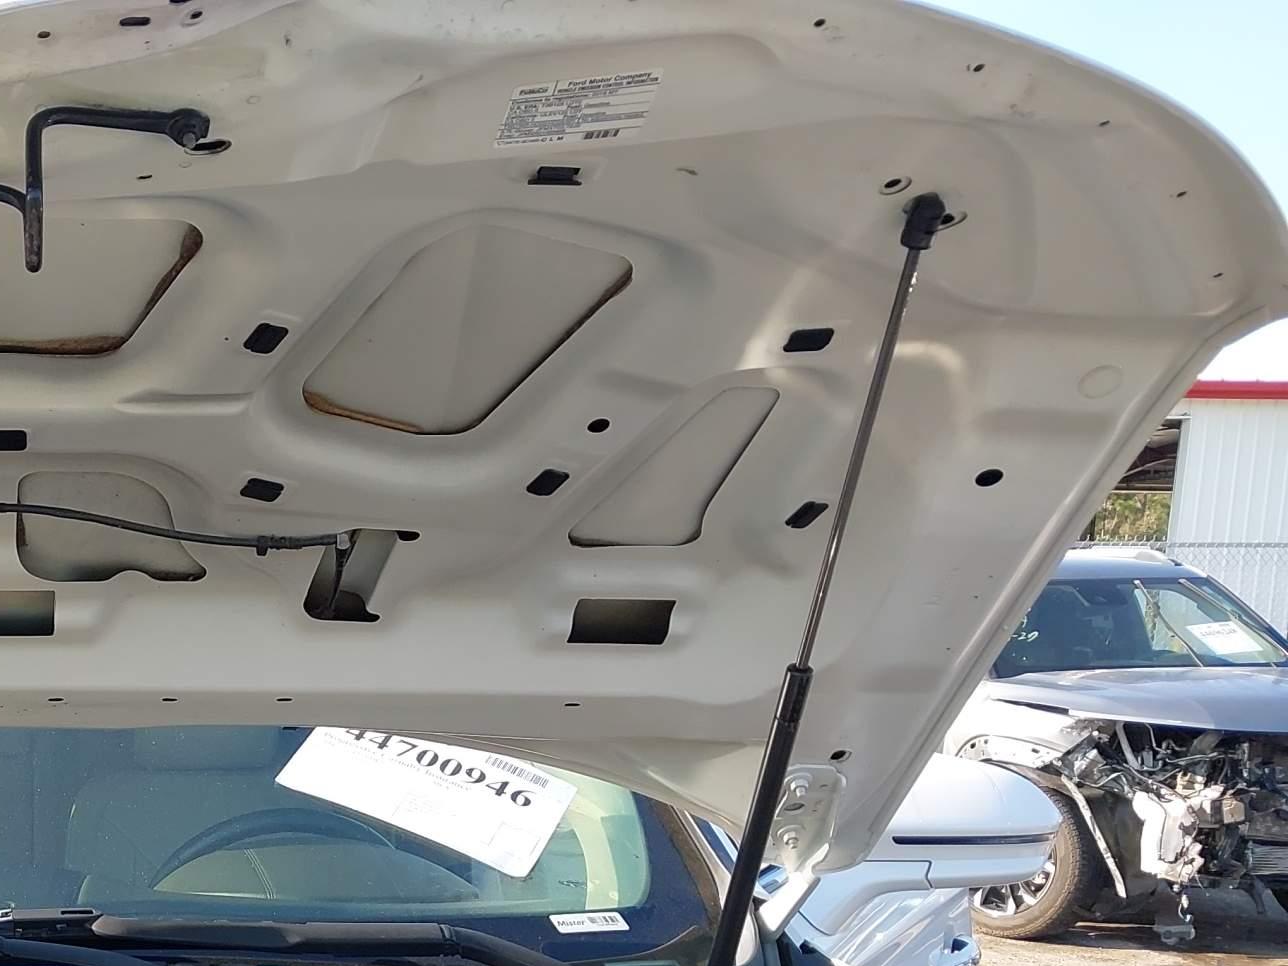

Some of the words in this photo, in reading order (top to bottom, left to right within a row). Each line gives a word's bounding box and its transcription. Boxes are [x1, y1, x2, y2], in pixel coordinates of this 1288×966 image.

[568, 79, 588, 88] Ford
[588, 76, 613, 85] Motor
[613, 71, 653, 82] Company
[345, 728, 537, 807] 44700946
